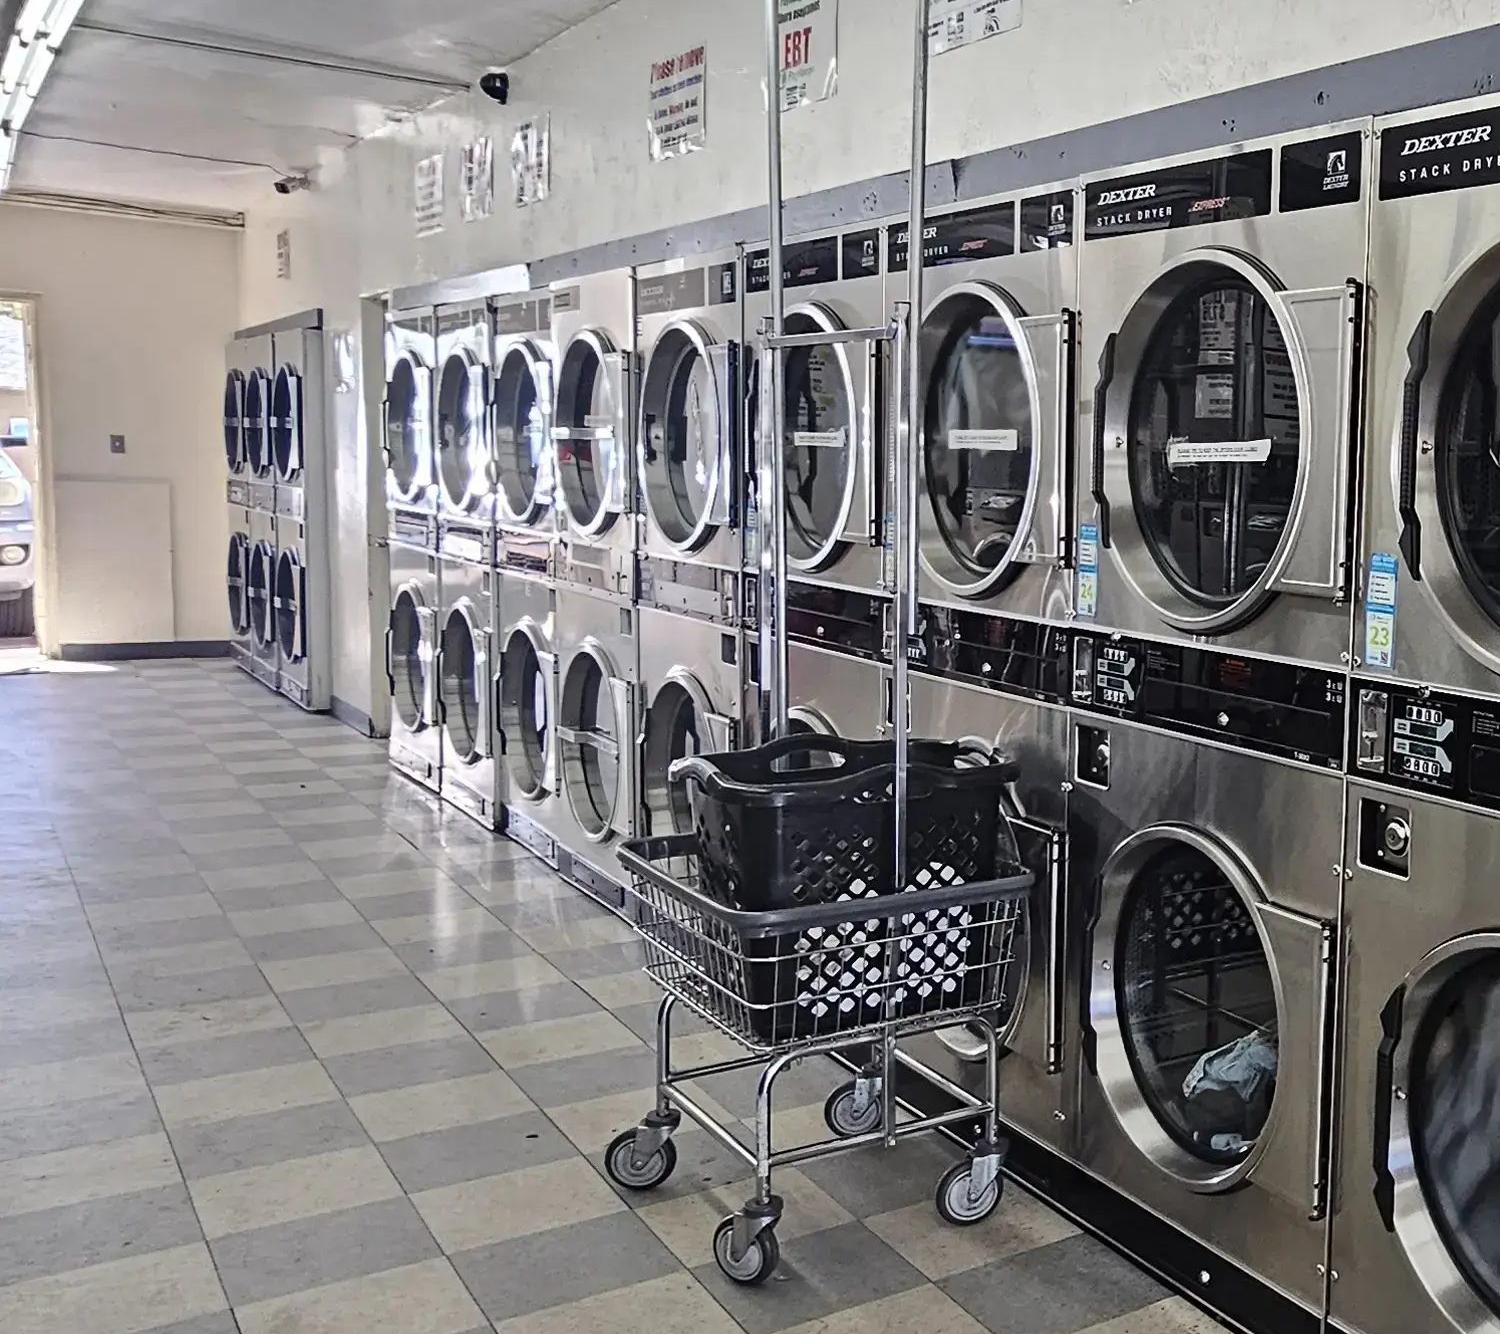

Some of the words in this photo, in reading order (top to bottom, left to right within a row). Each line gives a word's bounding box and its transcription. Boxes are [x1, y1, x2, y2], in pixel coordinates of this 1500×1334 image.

[784, 26, 812, 69] EBT
[1401, 125, 1491, 156] DEXTER
[1399, 163, 1451, 182] STACK
[1097, 184, 1156, 205] DEXTER
[1097, 213, 1131, 227] STACK
[1138, 206, 1172, 220] DRYER
[896, 227, 937, 244] DEER
[1370, 626, 1389, 647] 23
